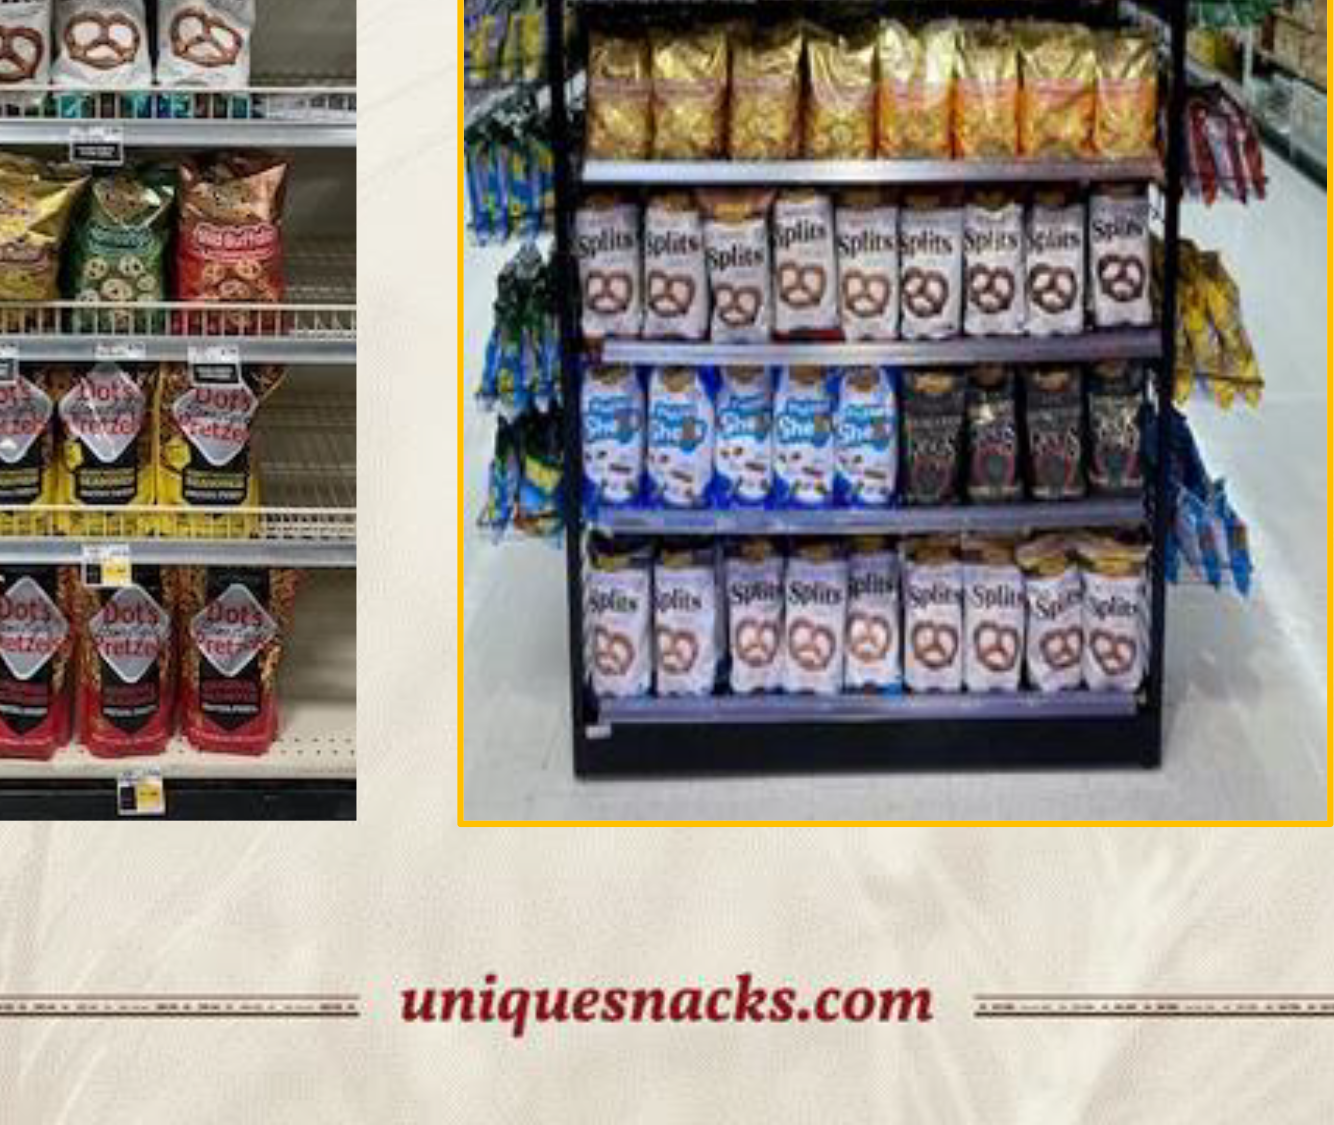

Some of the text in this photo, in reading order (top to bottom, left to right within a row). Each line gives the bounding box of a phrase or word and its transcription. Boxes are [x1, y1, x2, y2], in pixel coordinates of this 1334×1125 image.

[708, 243, 763, 269] Splits
[838, 230, 893, 258] Splits
[899, 231, 953, 257] Splits
[973, 584, 1019, 609] Split
[104, 602, 159, 624] Dot's
[206, 603, 263, 625] Dot's
